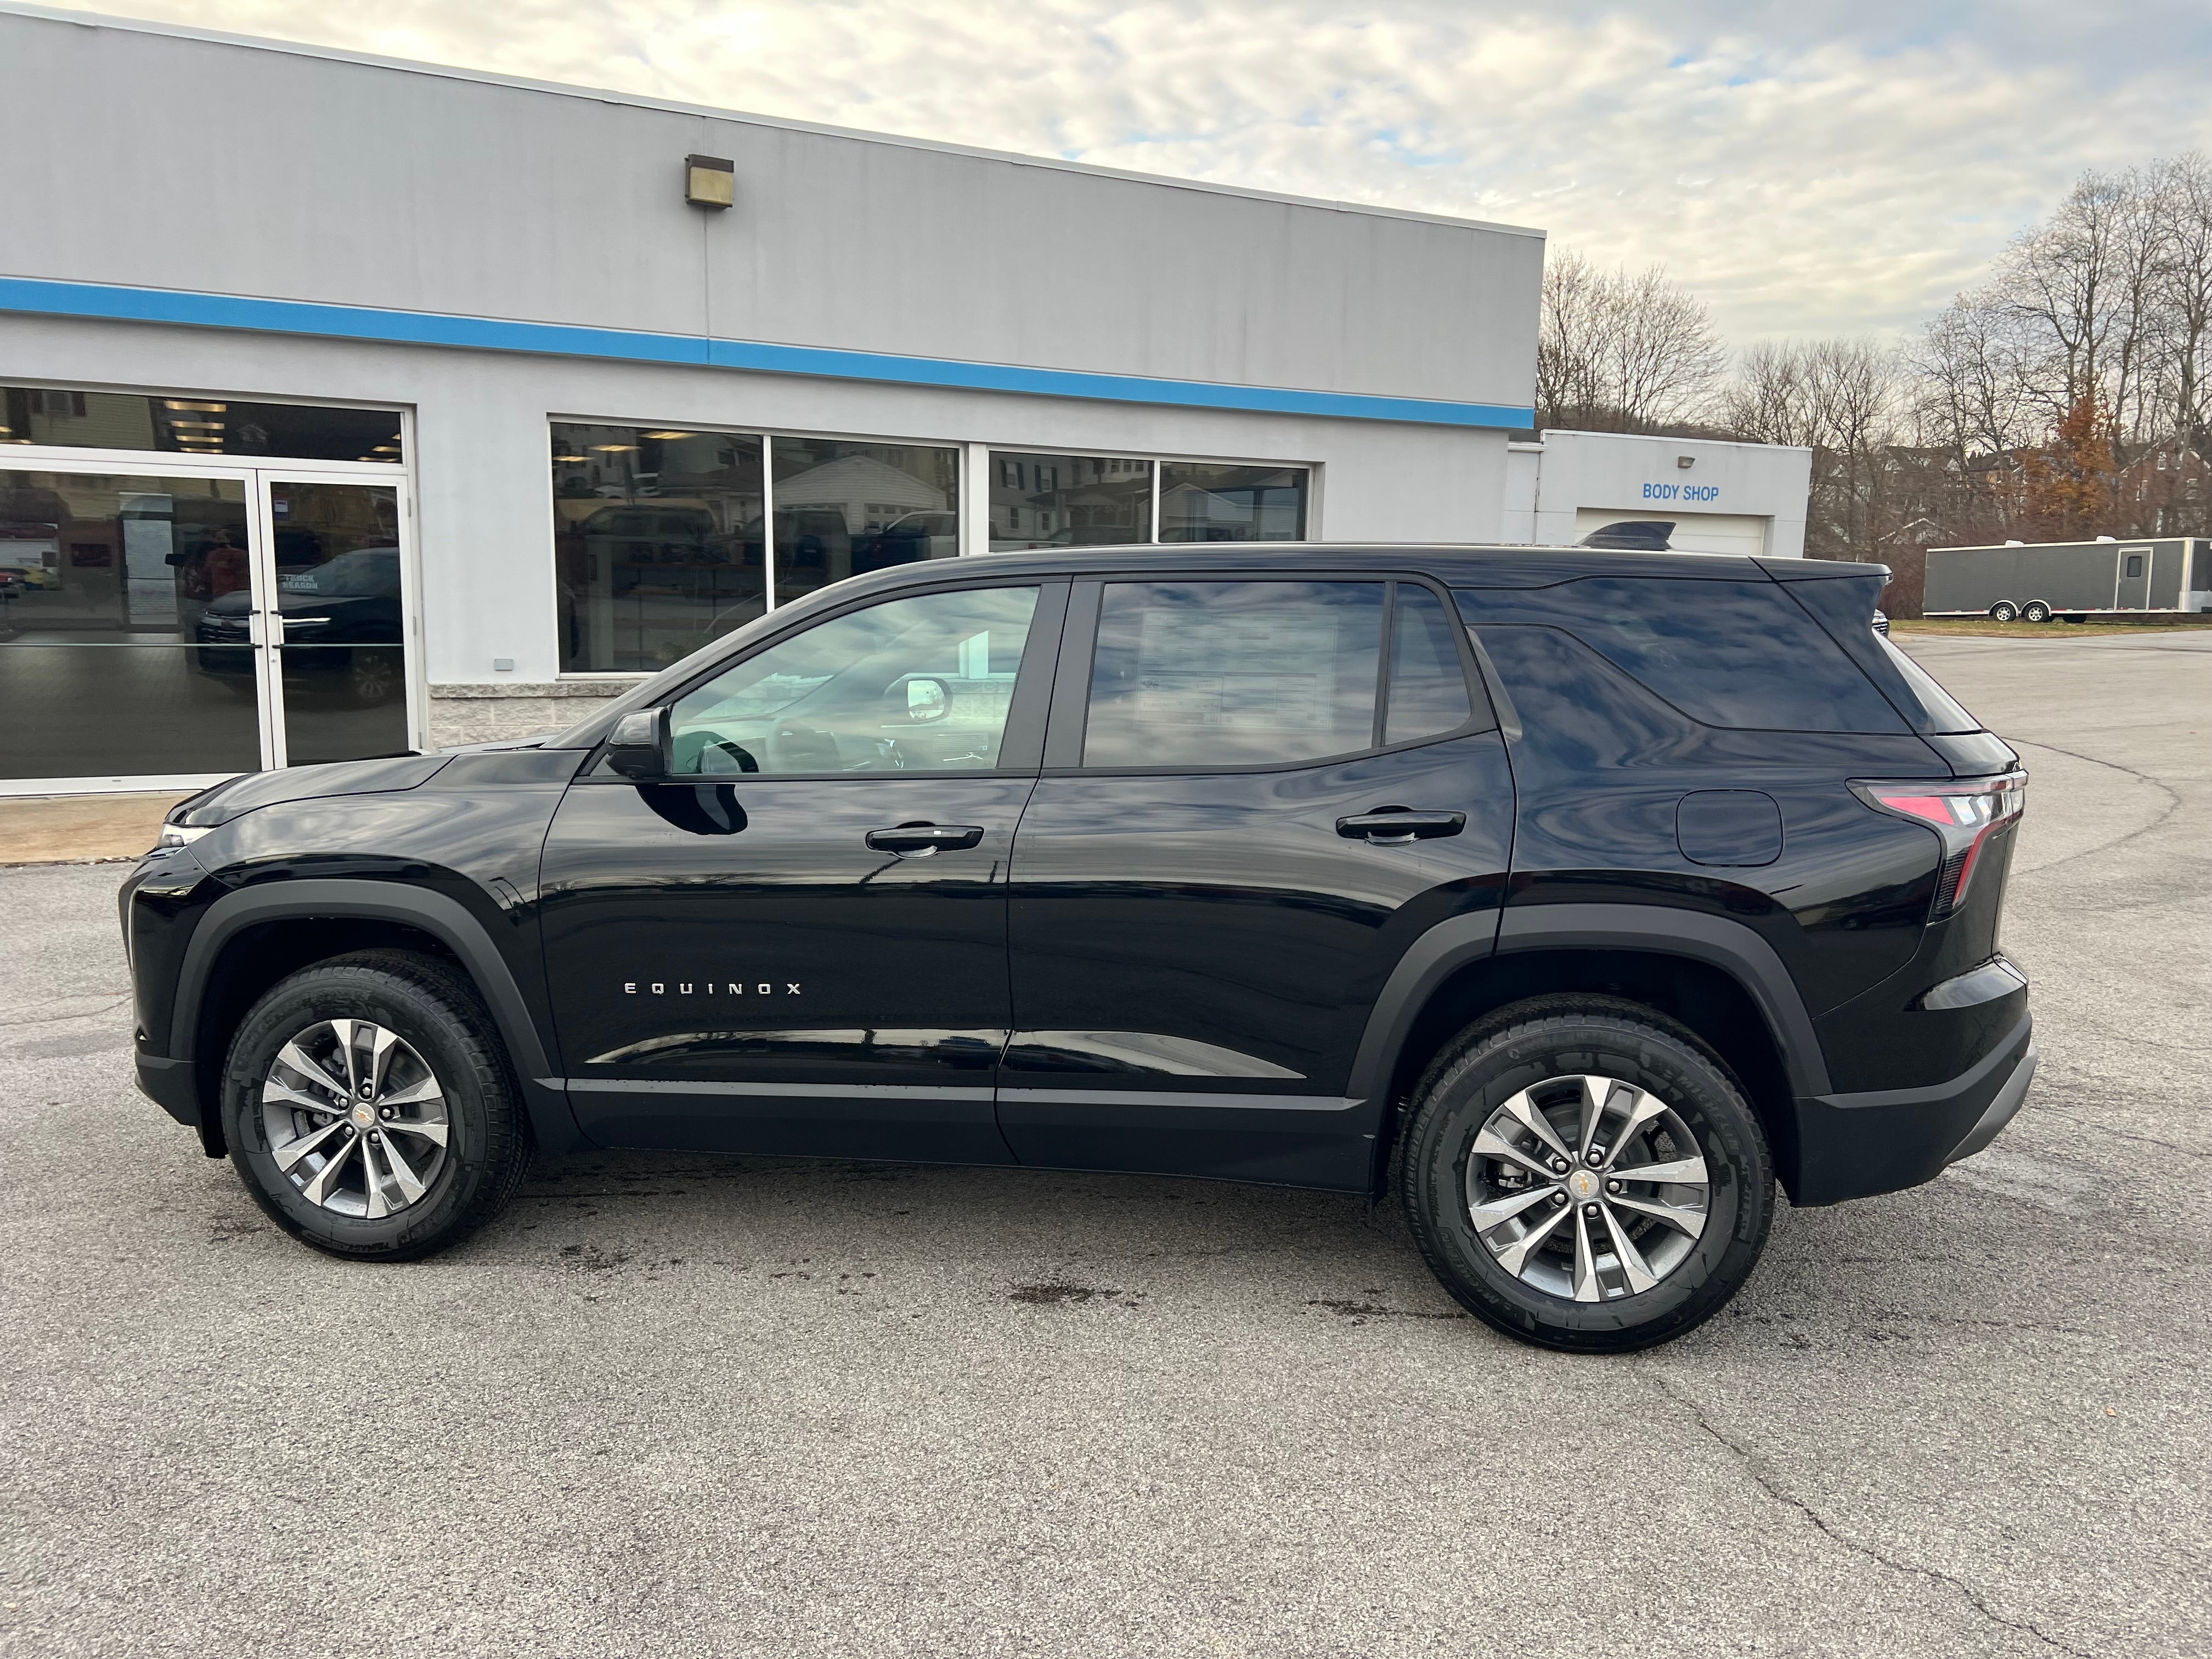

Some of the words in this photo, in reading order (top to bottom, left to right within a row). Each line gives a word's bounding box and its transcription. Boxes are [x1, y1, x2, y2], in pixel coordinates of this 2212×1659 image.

[1643, 483, 1680, 500] BODY
[1683, 486, 1719, 501] SHOP
[624, 983, 800, 995] EQUINOX
[1677, 1075, 1740, 1150] MICHELIN
[1440, 1232, 1499, 1305] MICHELIN
